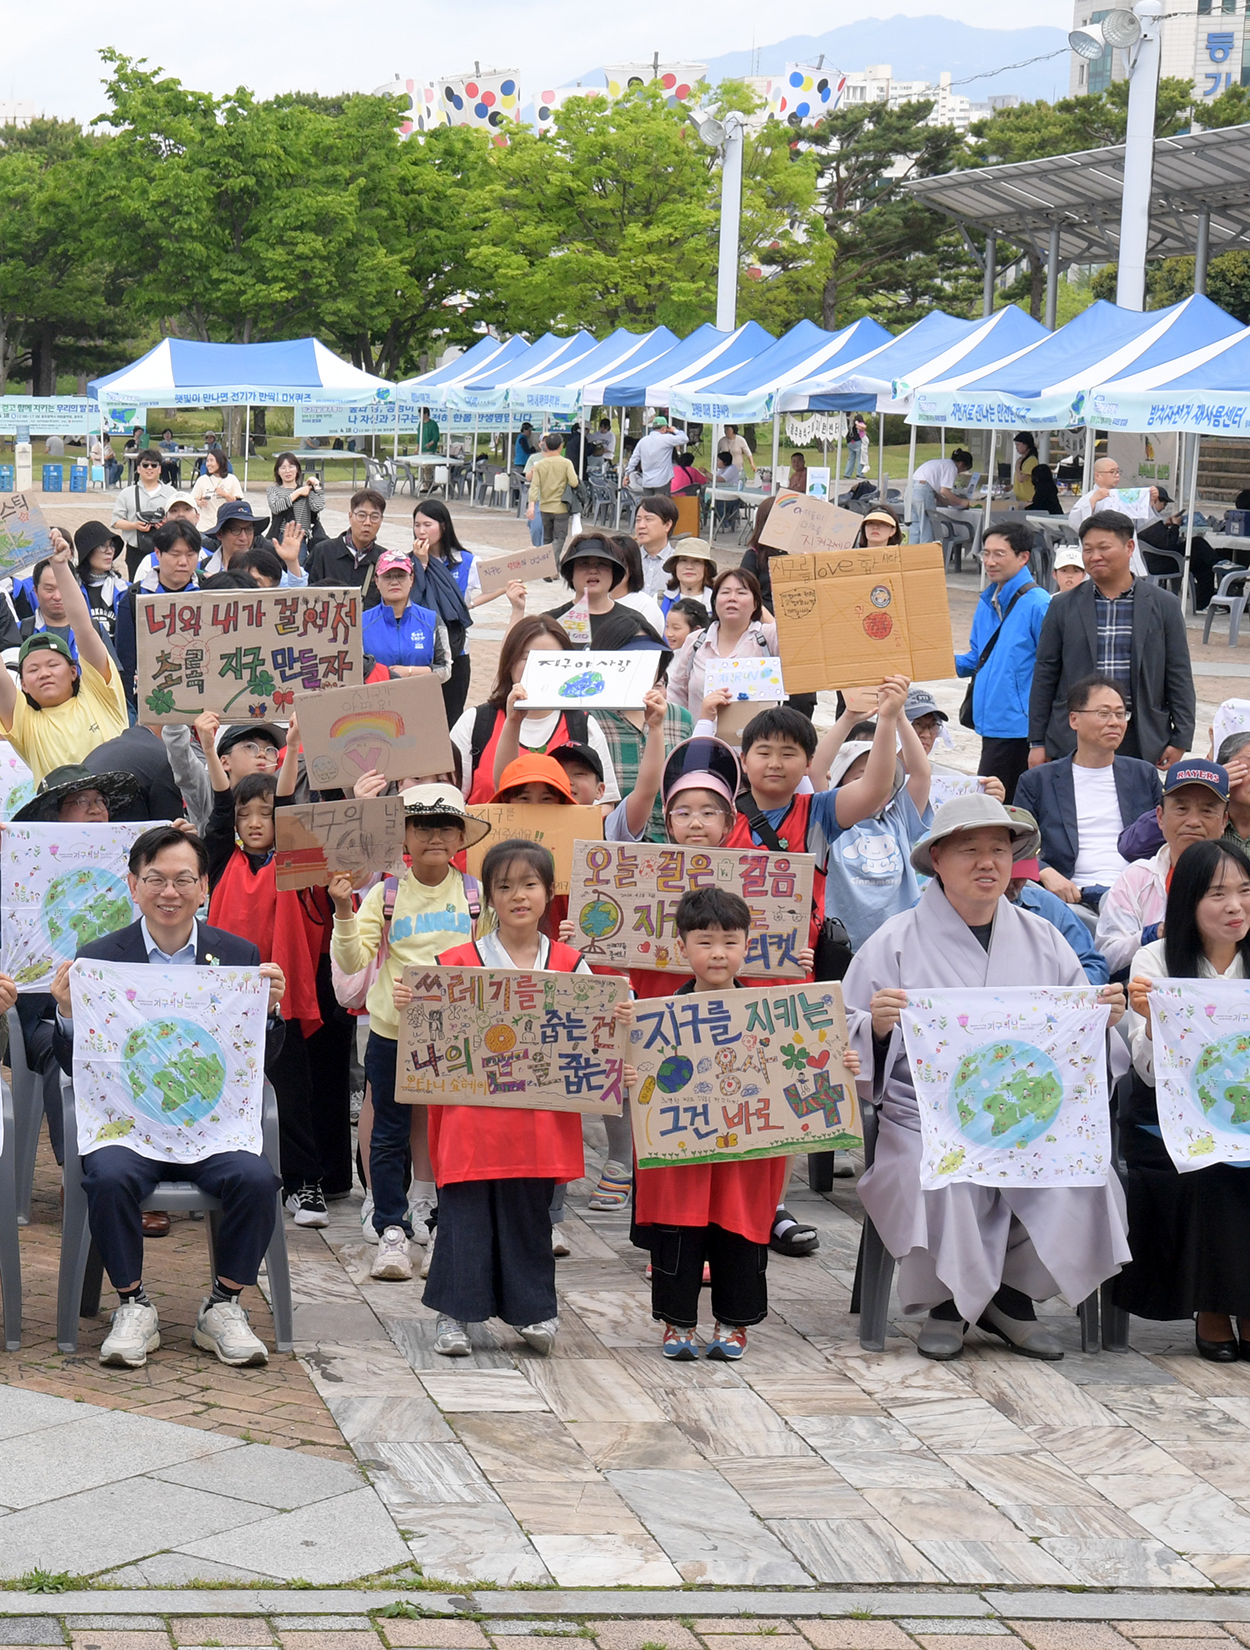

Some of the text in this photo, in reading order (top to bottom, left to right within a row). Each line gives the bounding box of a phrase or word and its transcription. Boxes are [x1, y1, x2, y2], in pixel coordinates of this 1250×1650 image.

[1, 404, 16, 412] 걷고
[17, 404, 32, 412] 함께
[33, 404, 55, 412] 지키는
[56, 404, 78, 412] 우리의
[175, 394, 200, 403] 햇빛이
[202, 393, 229, 402] 만나면
[231, 392, 256, 401] 전기가
[259, 392, 279, 402] 반짝!
[282, 393, 311, 403] OX퀴즈
[348, 415, 358, 424] 나
[453, 414, 472, 423] 한몸
[951, 403, 974, 421] 자전거로
[975, 403, 995, 422] 만나는
[1147, 404, 1247, 428] 방치자전거 재사용센터
[771, 556, 812, 583] 지구를
[813, 555, 854, 580] love
[145, 604, 201, 637] 너와
[211, 600, 266, 634] 내가
[274, 590, 356, 644] 걸어서
[563, 620, 587, 632] 모두
[152, 646, 353, 693] 초록 지구 만들자
[596, 659, 632, 673] 사랑
[351, 687, 395, 701] 지구가
[293, 797, 364, 842] 지구의
[473, 808, 515, 824] 지구를
[584, 846, 803, 903] 오늘 걸은 걸음,
[154, 998, 183, 1008] 지구의날
[411, 975, 543, 1011] 쓰레기를
[636, 992, 834, 1049] 지구를 지키는
[988, 1020, 1018, 1030] 지구의날
[411, 1037, 474, 1077] 나의
[715, 1046, 778, 1096] 용사
[402, 1074, 488, 1095] 오타니 쇼헤이
[659, 1070, 845, 1140] 그건 바로 나
